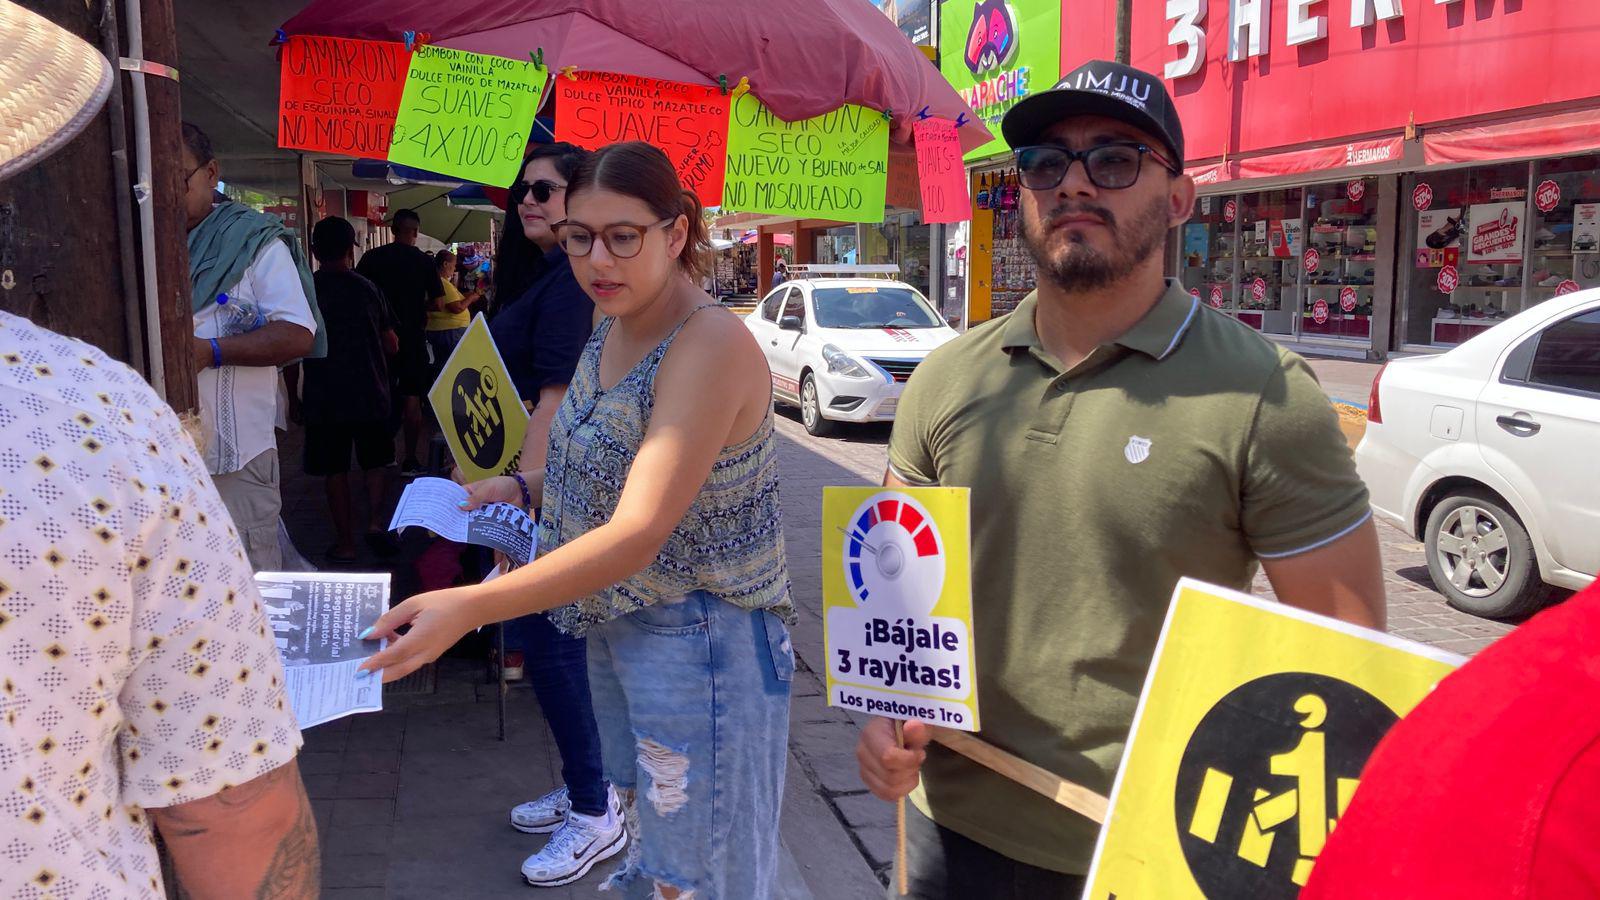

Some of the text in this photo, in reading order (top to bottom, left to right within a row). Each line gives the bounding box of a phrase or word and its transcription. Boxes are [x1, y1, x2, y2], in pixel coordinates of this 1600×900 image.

[1164, 0, 1206, 80] 3
[289, 38, 397, 82] CAMARON
[418, 46, 529, 71] BOMBON CON COCO Y
[450, 63, 494, 75] VAINILLA
[305, 79, 371, 106] SECO
[410, 69, 442, 83] DULCE
[447, 74, 475, 86] TIPICO
[480, 78, 493, 88] DE
[605, 85, 660, 98] VAINILLA
[635, 77, 649, 86] DE
[656, 81, 690, 93] COCO
[705, 88, 711, 96] Y
[285, 101, 299, 110] DE
[412, 85, 513, 119] SUAVES
[564, 88, 722, 116] DULCE TIPICO MAZATLECO
[283, 115, 306, 146] NO
[571, 106, 701, 148] SUAVES
[750, 132, 822, 156] SECO
[727, 154, 790, 177] NUEVO
[799, 159, 808, 177] Y
[812, 158, 857, 178] BUENO
[865, 160, 886, 174] SAL
[725, 181, 862, 211] NO MOSQUEADO
[1539, 187, 1557, 206] 30%
[1473, 227, 1510, 244] GRANDES
[321, 582, 332, 648] para el peatón.
[331, 583, 344, 658] de seguridad vial
[343, 583, 355, 647] Reglas básicas
[865, 618, 959, 652] ¡Bájale
[837, 649, 961, 690] 3 rayitas!
[840, 691, 963, 724] Los peatones 1ro
